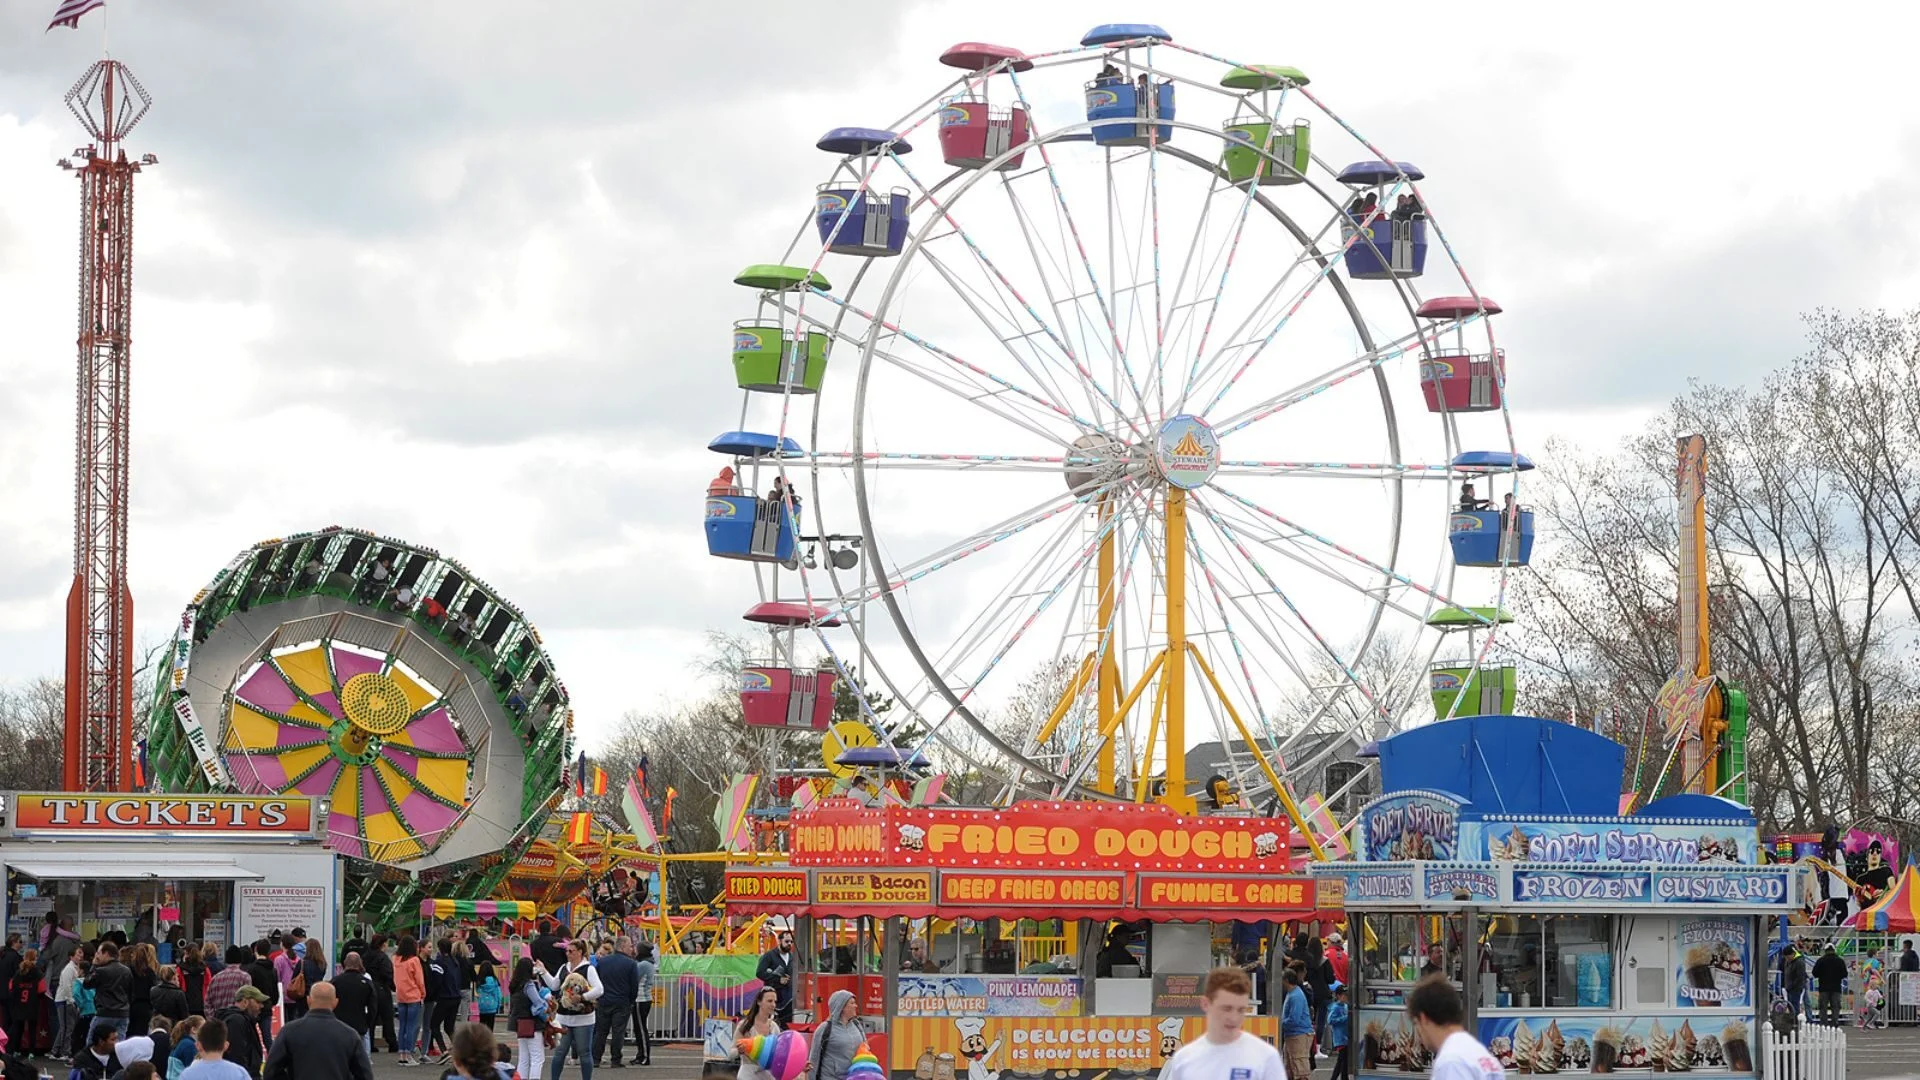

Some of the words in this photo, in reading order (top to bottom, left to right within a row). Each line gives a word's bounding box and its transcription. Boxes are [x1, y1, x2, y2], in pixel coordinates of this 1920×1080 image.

[43, 799, 288, 826] TICKETS
[1371, 806, 1404, 847] SOFT
[1407, 800, 1453, 846] SERVE
[796, 825, 834, 852] FRIED
[837, 825, 881, 852] DOUGH
[927, 823, 1080, 856] FRIED
[1094, 828, 1253, 859] DOUGH
[1528, 832, 1600, 862] SOFT
[1605, 829, 1700, 864] SERVE
[730, 876, 760, 896] FRIED
[762, 876, 802, 897] DOUGH
[822, 875, 865, 885] MAPLE
[870, 874, 926, 889] Bacon
[946, 878, 995, 899] DEEP
[1000, 878, 1056, 899] FRIED
[1060, 880, 1120, 900] OREOS
[1358, 874, 1413, 897] SUNDAES
[1429, 880, 1498, 898] FLOATS
[1518, 876, 1647, 899] FROZEN
[1657, 876, 1783, 900] CUSTARD
[243, 888, 265, 896] STATE
[267, 888, 283, 896] LAW
[285, 888, 322, 896] REQUIRES
[821, 891, 867, 900] FRIED
[872, 891, 927, 901] DOUGH
[1150, 882, 1240, 903] FUNNEL
[1248, 883, 1303, 904] CAKE
[1682, 921, 1744, 933] ROOTBEER
[1683, 928, 1746, 945] FLOATS
[989, 983, 1014, 996] PINK
[1016, 982, 1076, 997] LEMONADE!
[1680, 983, 1747, 1000] SUNDAES
[898, 997, 944, 1011] BOTTLED
[946, 997, 985, 1010] WATER!
[1013, 1029, 1151, 1044] DELICIOUS
[1012, 1048, 1029, 1060] IS
[1034, 1048, 1072, 1060] HOW
[1077, 1048, 1101, 1059] WE
[1105, 1048, 1151, 1059] ROLL!
